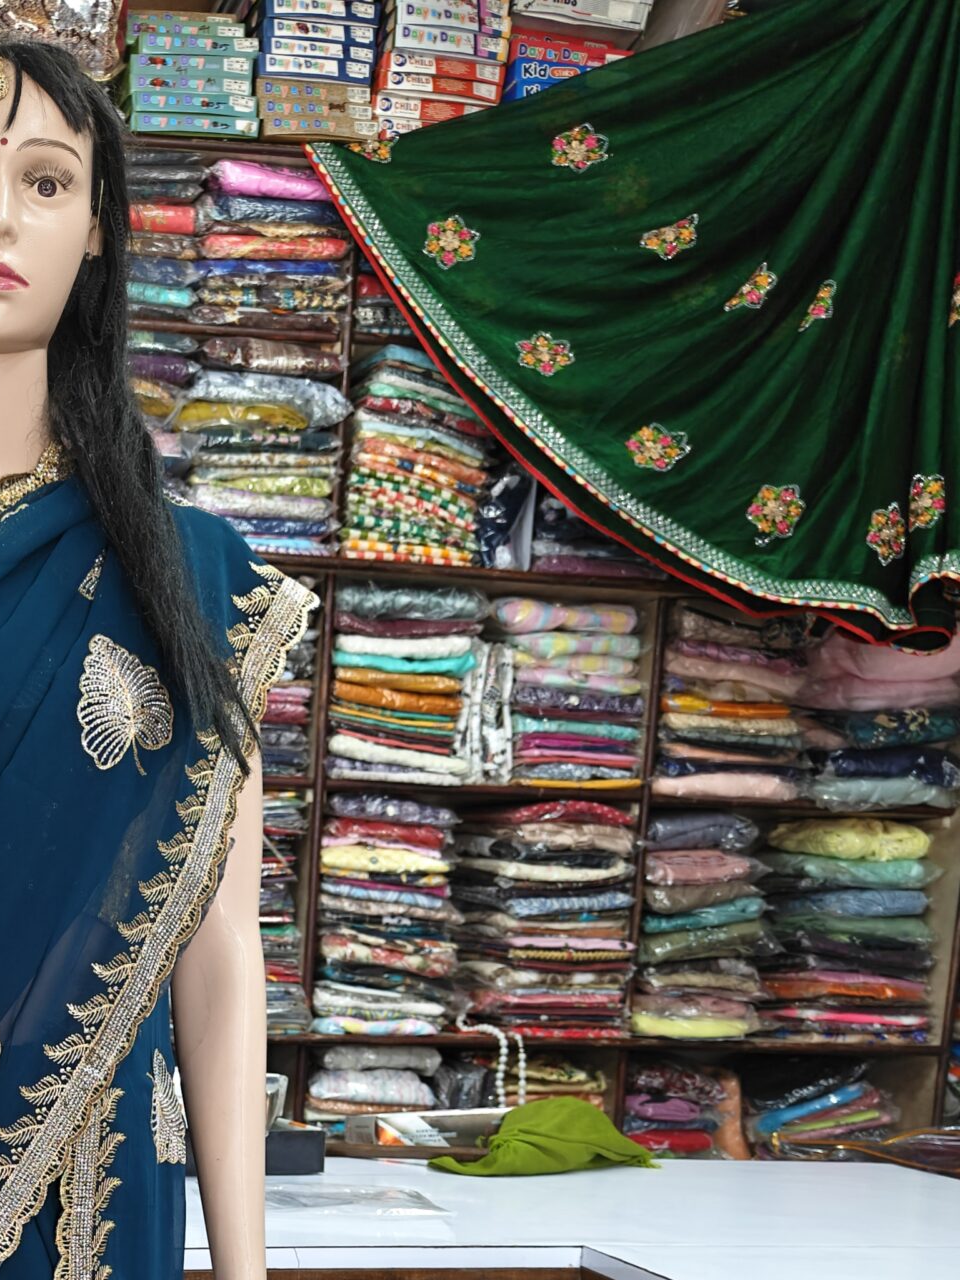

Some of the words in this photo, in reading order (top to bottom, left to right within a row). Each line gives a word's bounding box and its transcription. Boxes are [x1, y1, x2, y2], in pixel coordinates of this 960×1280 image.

[402, 26, 425, 44] Day
[440, 31, 462, 47] Day
[518, 43, 545, 61] Day
[562, 48, 588, 66] Day
[522, 61, 549, 80] Kid
[523, 85, 542, 97] Ki
